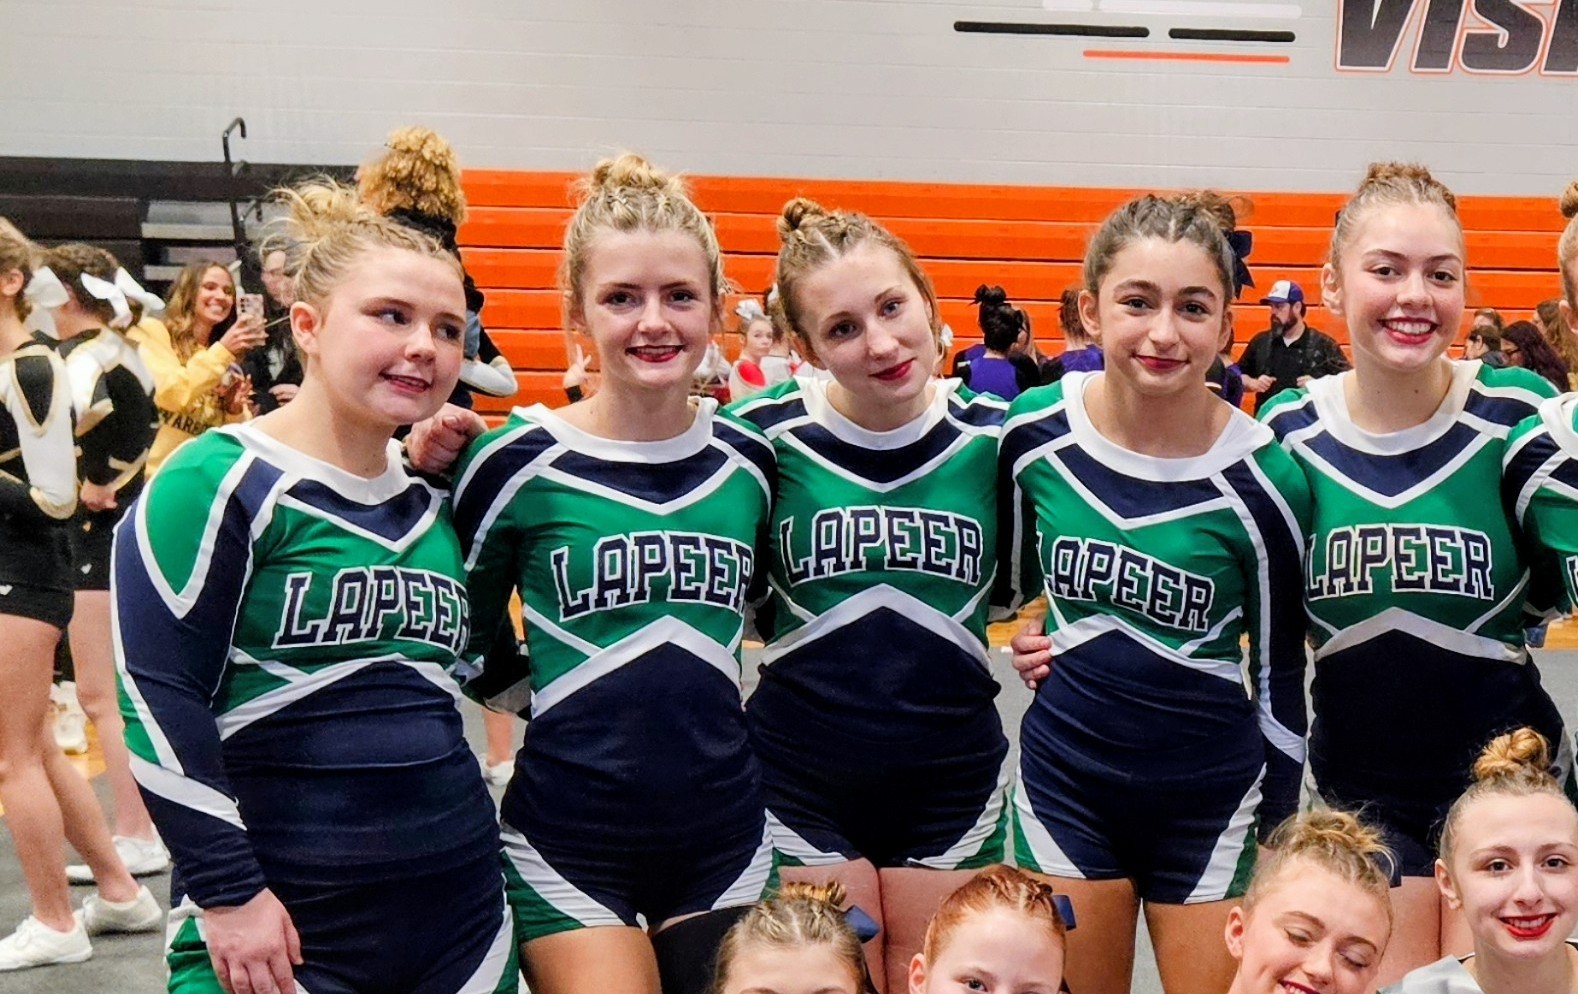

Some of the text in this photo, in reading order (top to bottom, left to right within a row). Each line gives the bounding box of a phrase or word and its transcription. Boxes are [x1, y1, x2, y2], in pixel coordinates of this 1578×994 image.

[551, 530, 754, 622] LAPEER
[780, 505, 983, 587] LAPEER
[1304, 523, 1495, 601] LAPEER
